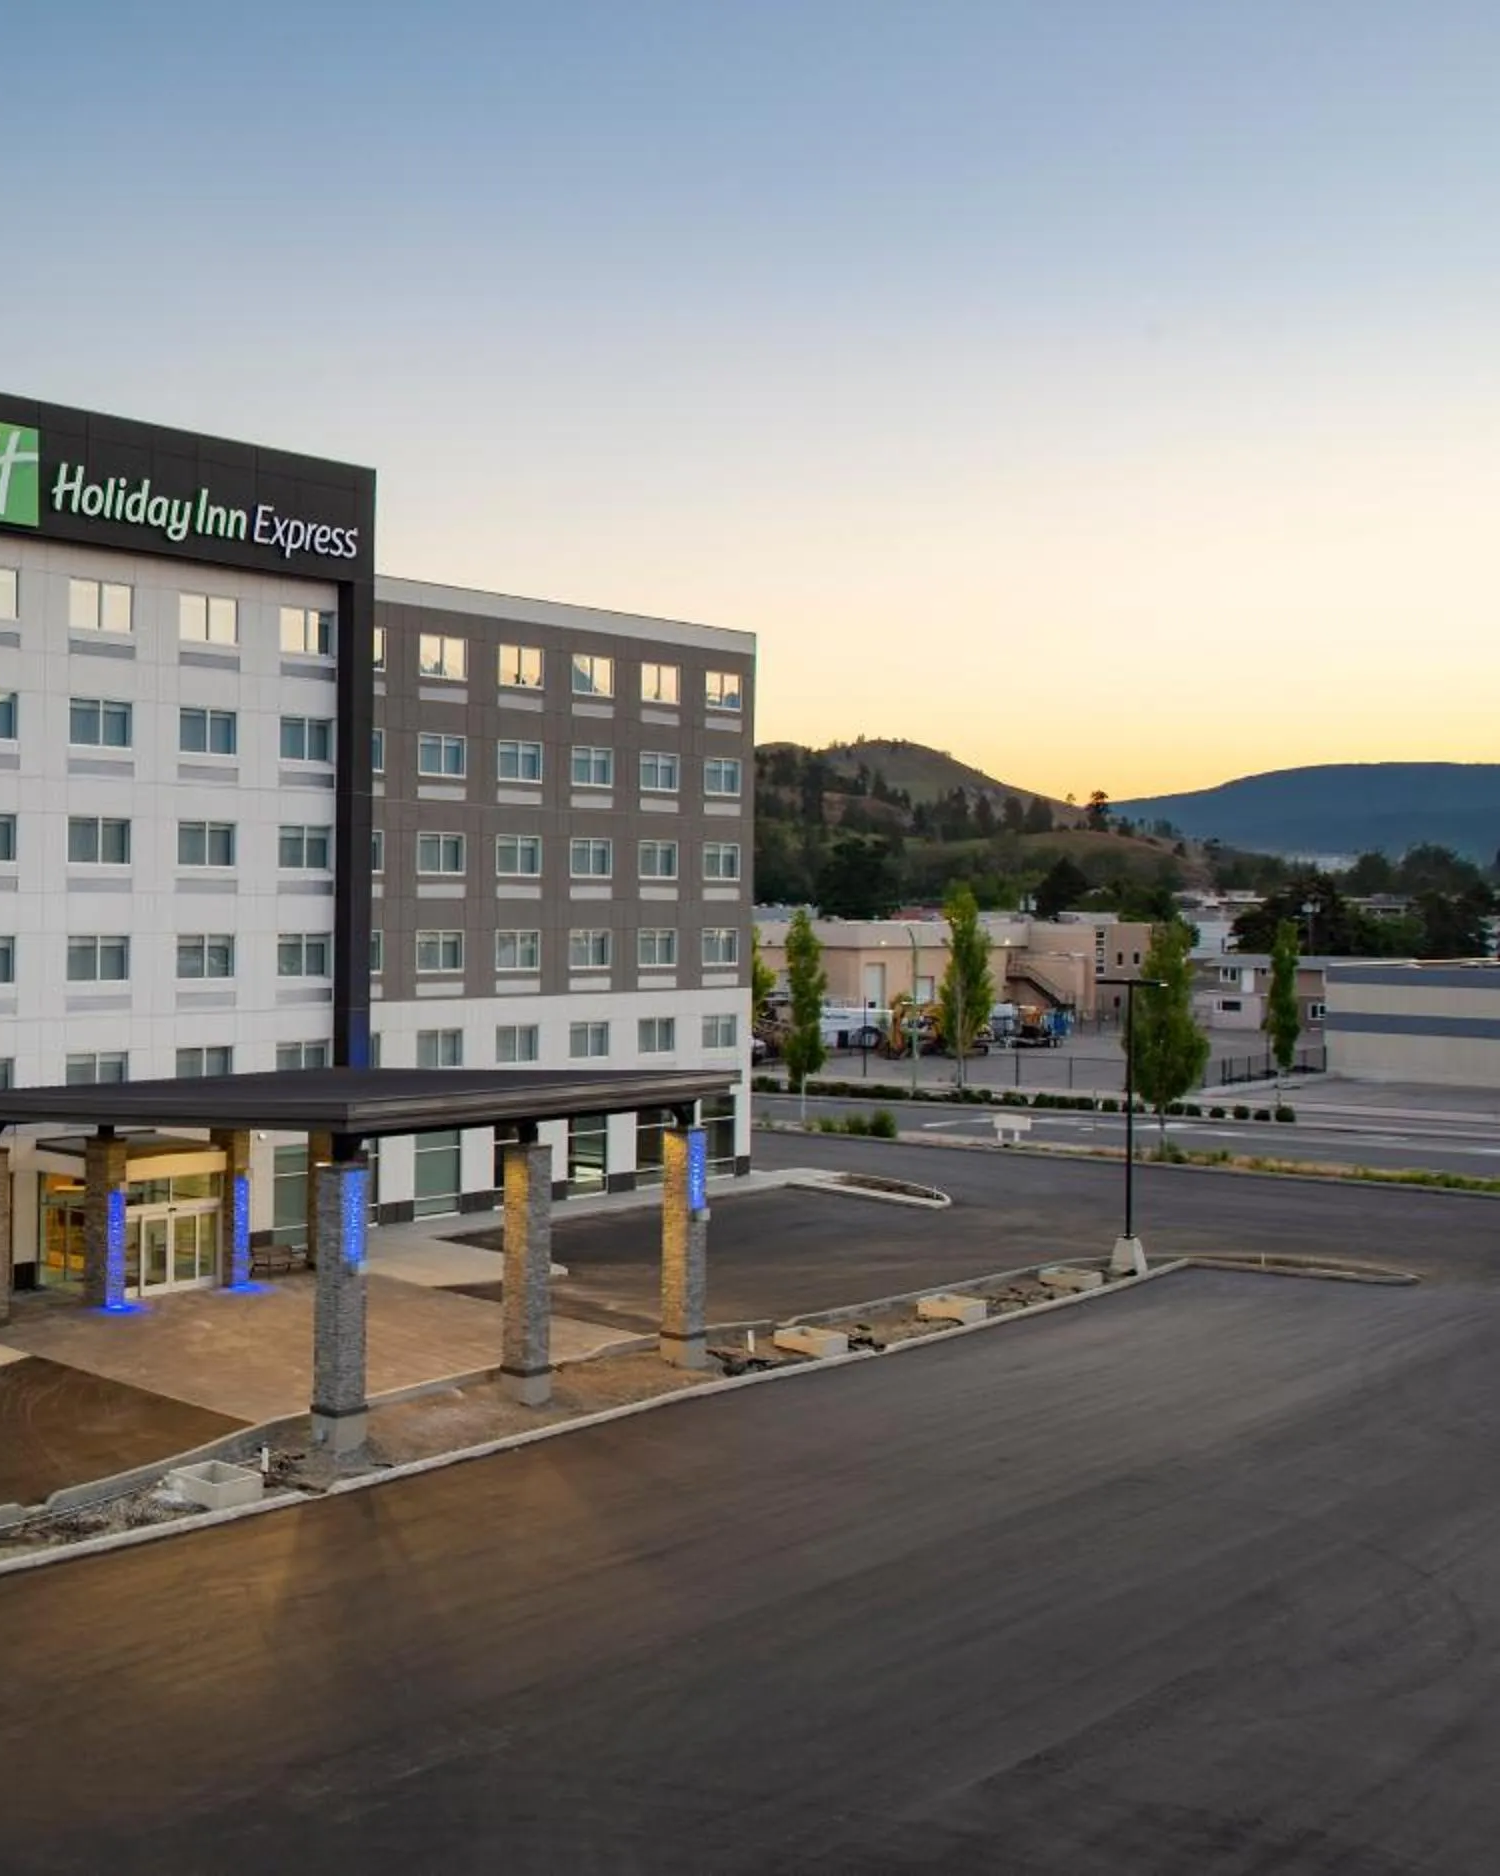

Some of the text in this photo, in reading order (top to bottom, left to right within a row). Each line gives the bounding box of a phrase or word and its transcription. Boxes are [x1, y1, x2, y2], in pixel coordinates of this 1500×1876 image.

[51, 462, 359, 559] Holiday Inn Express
